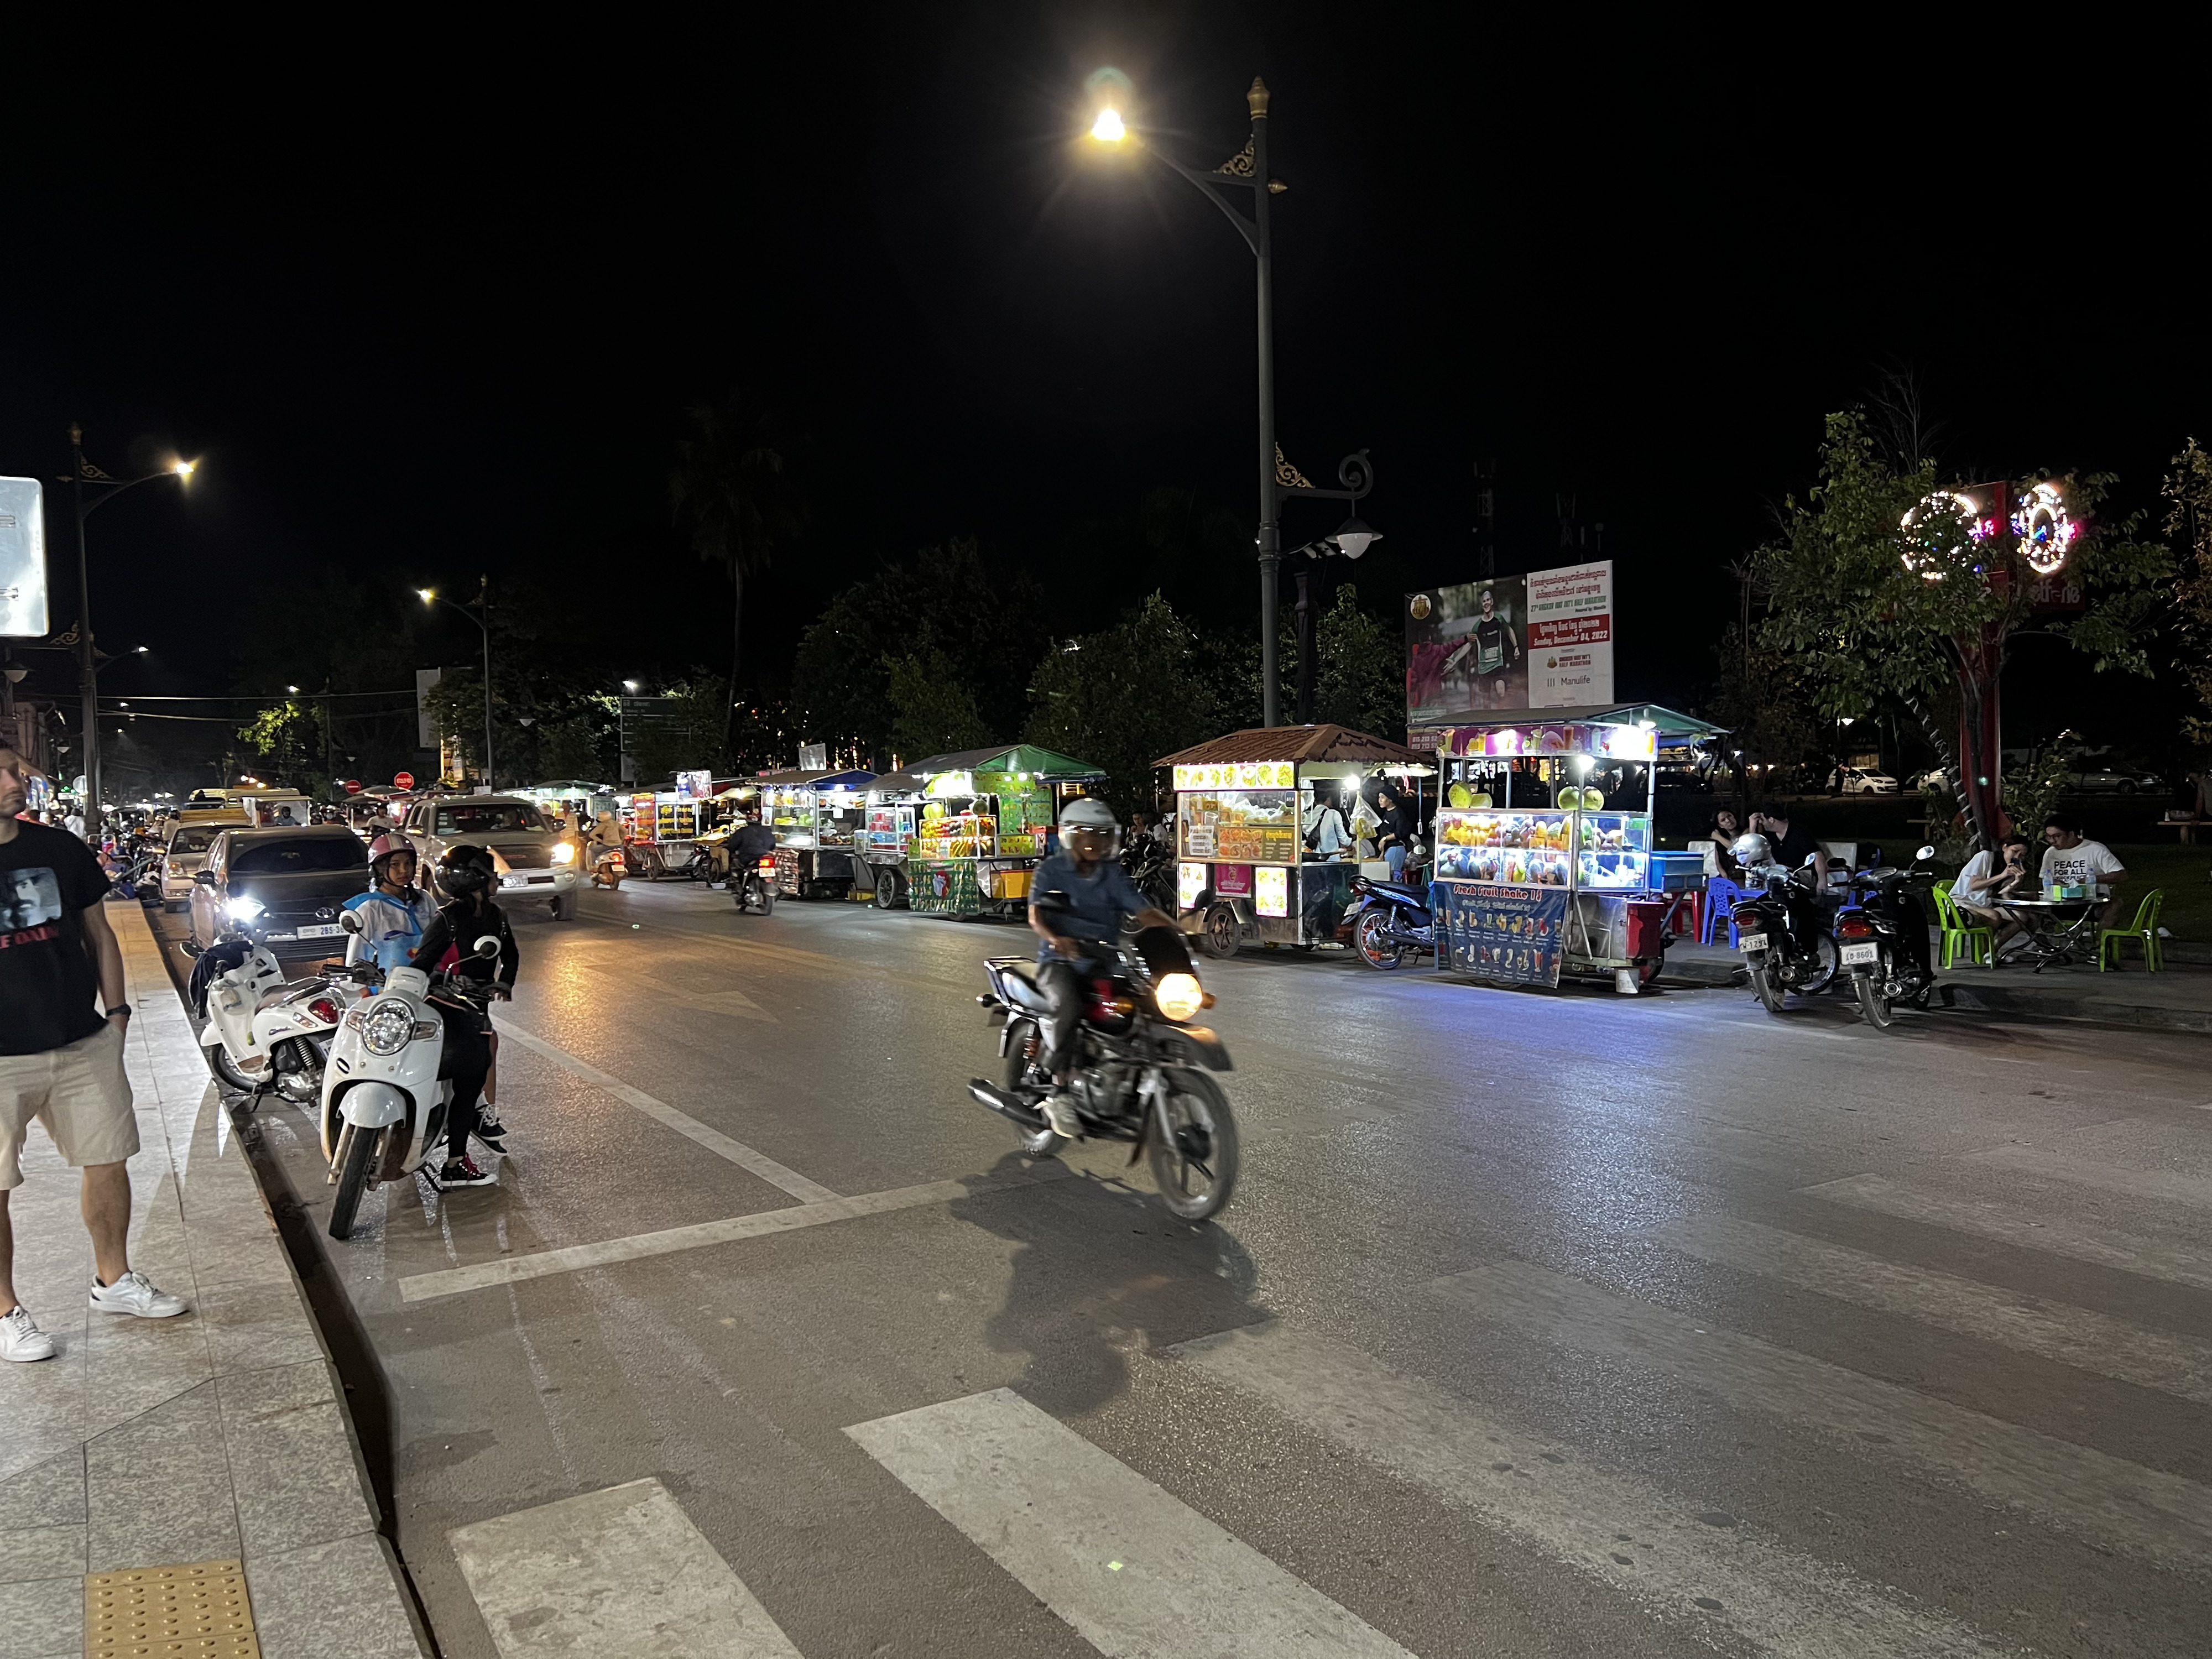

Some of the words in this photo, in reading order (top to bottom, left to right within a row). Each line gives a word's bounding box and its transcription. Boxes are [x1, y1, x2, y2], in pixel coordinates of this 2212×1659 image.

[1554, 634, 1579, 644] December
[1592, 630, 1608, 640] 2022
[1561, 675, 1591, 686] Manulife
[2054, 860, 2085, 869] PEACE
[1453, 884, 1477, 896] Fresh
[1478, 886, 1499, 898] Fruit
[1500, 888, 1528, 900] Shake
